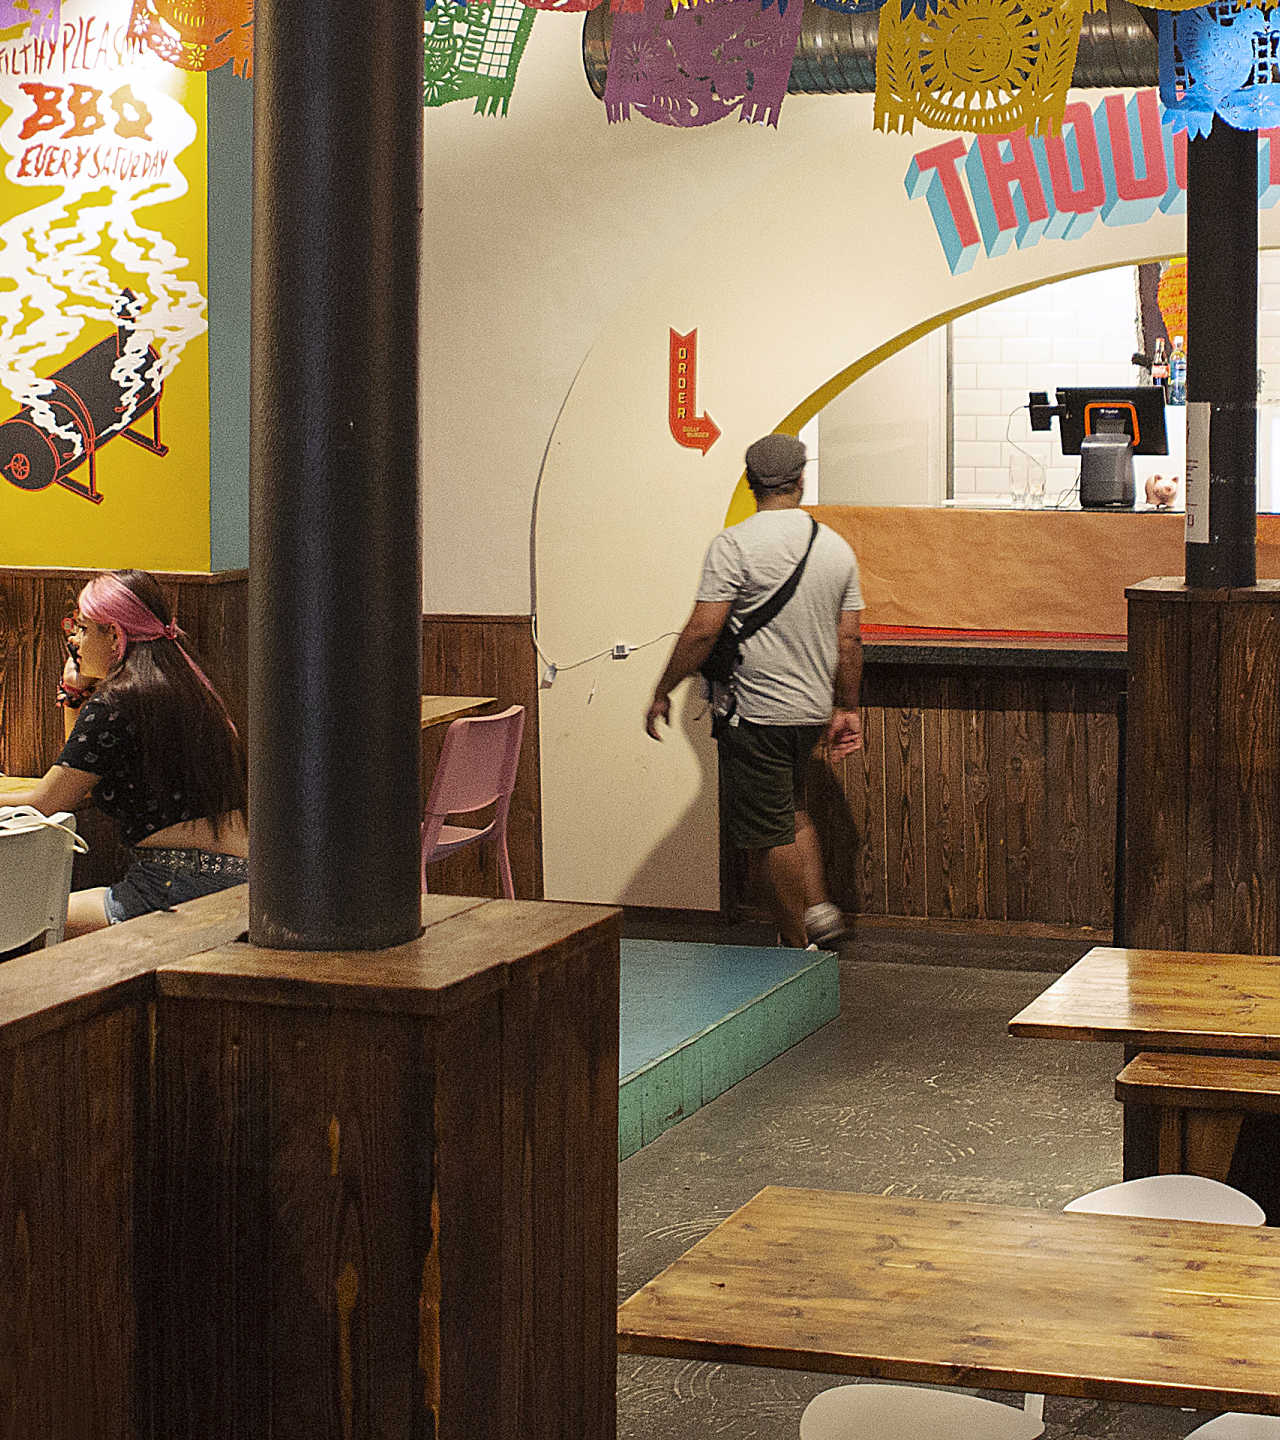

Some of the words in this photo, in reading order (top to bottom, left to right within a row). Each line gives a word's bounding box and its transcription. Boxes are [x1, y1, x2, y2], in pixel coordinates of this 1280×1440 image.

[18, 82, 153, 142] BBQ
[17, 143, 89, 178] EVERY
[87, 144, 169, 182] SATURDAY
[677, 347, 688, 420] ORDER
